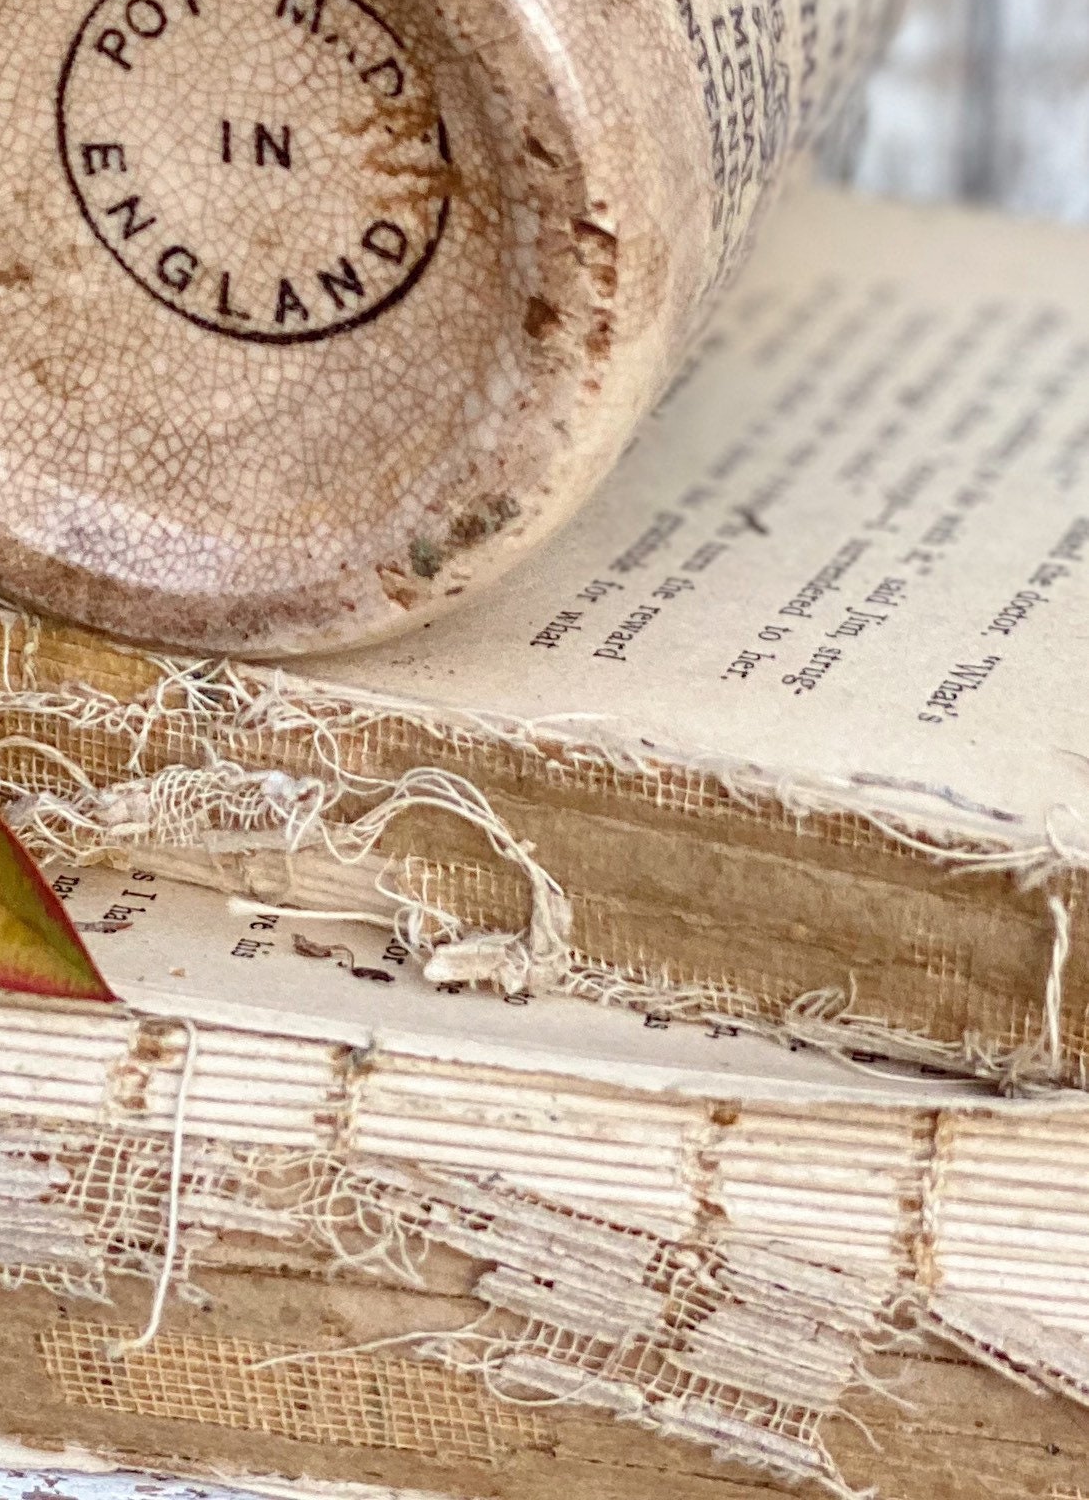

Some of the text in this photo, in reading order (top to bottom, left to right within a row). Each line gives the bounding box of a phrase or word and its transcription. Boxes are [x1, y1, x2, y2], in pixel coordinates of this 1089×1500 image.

[220, 119, 293, 171] IN
[80, 141, 410, 325] ENGLAND
[575, 578, 626, 604] for
[651, 575, 696, 601] the
[864, 576, 908, 608] said
[529, 609, 585, 650] what
[824, 605, 889, 639] Jim,
[980, 589, 1050, 637] doctor.
[592, 604, 662, 663] reward
[757, 624, 794, 643] to
[719, 649, 777, 681] her.
[780, 645, 843, 696] strug-
[230, 937, 276, 959] his
